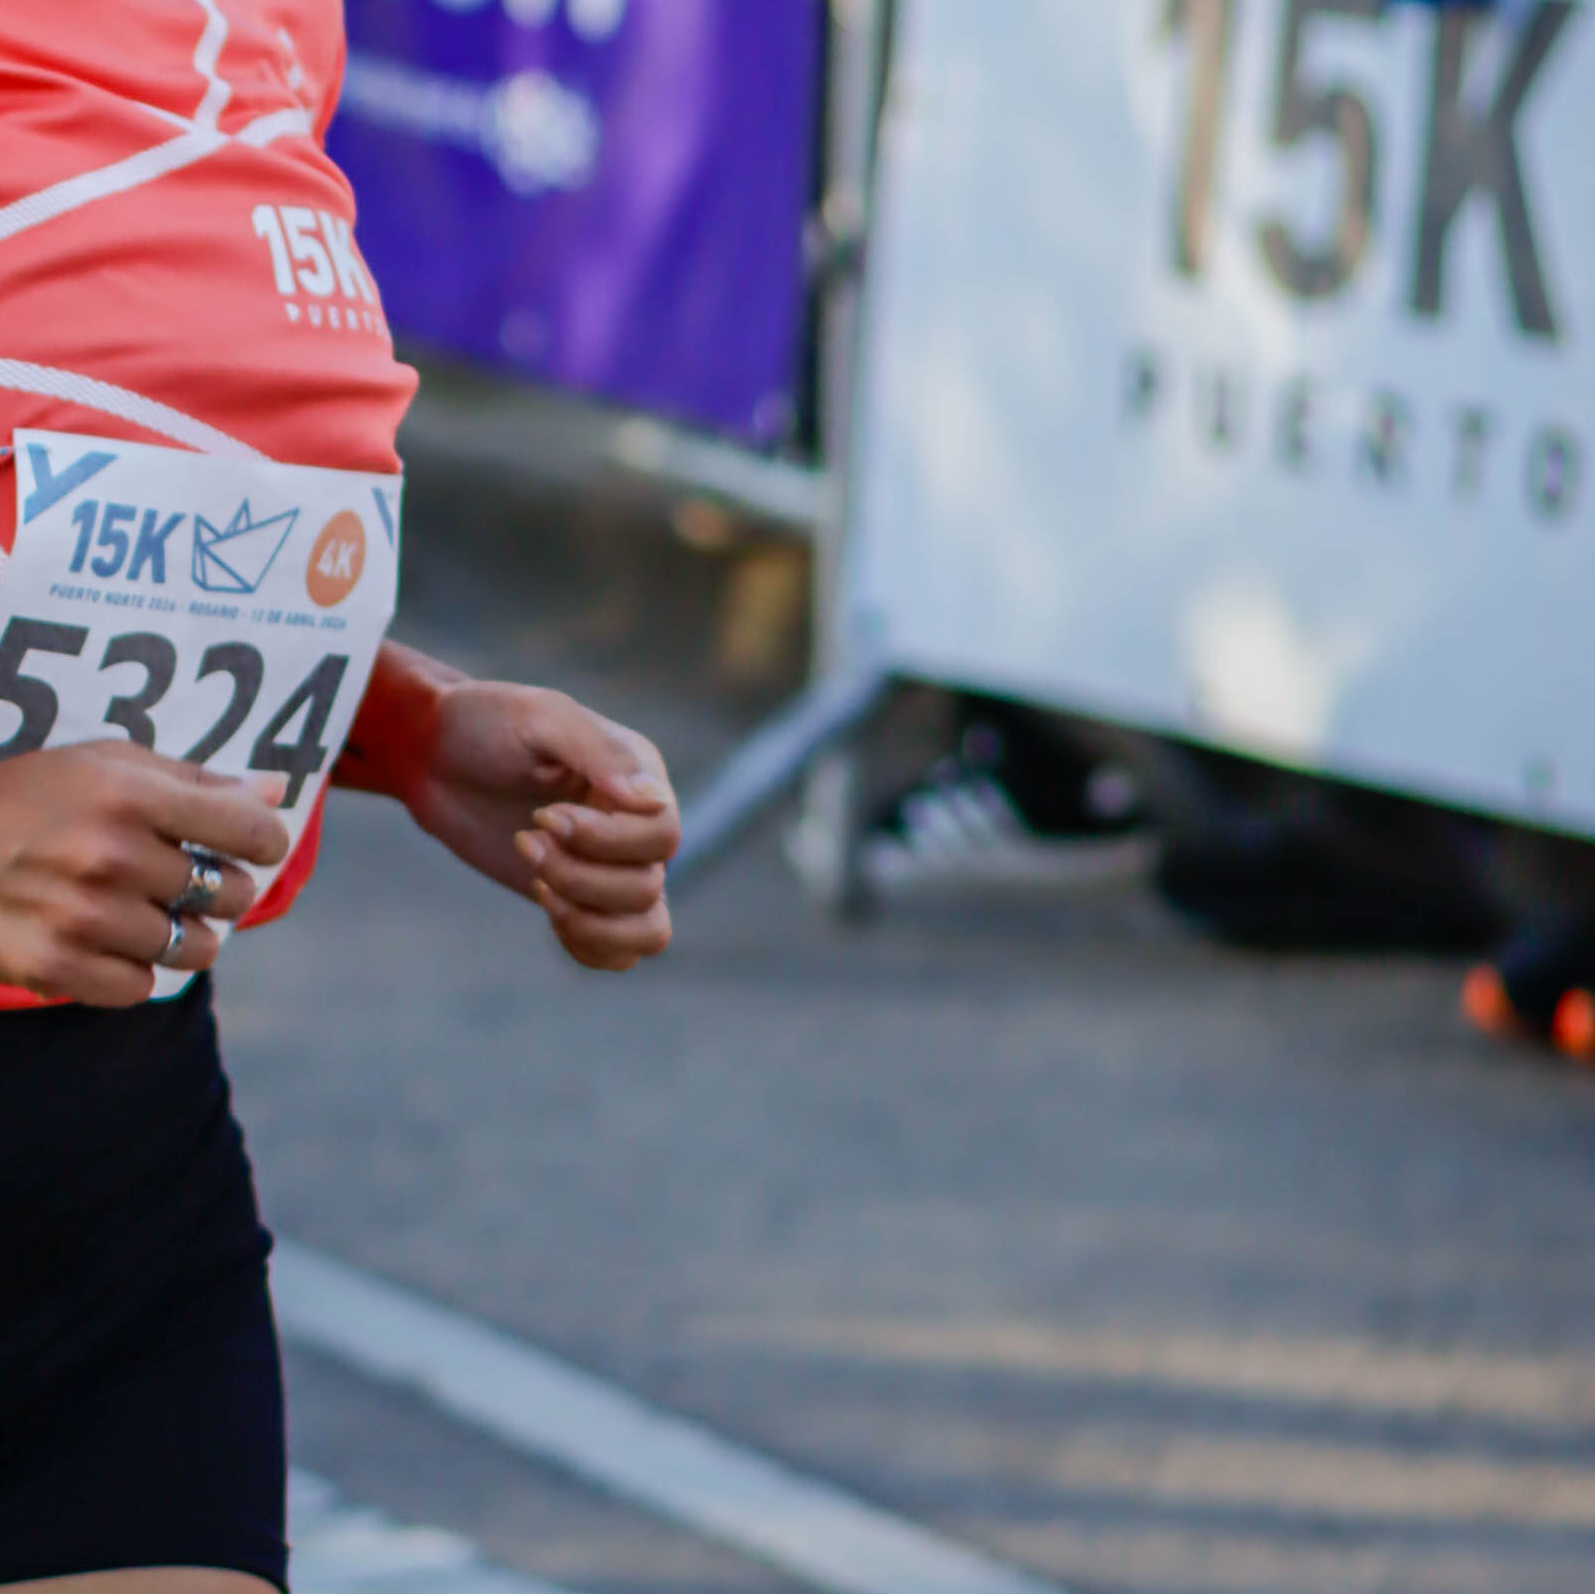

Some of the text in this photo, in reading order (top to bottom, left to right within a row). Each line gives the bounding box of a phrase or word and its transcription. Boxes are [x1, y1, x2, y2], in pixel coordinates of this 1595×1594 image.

[251, 204, 376, 304] 15K
[1120, 348, 1583, 527] PUERTO
[68, 499, 187, 585] 15K
[49, 583, 101, 604] PUERTO
